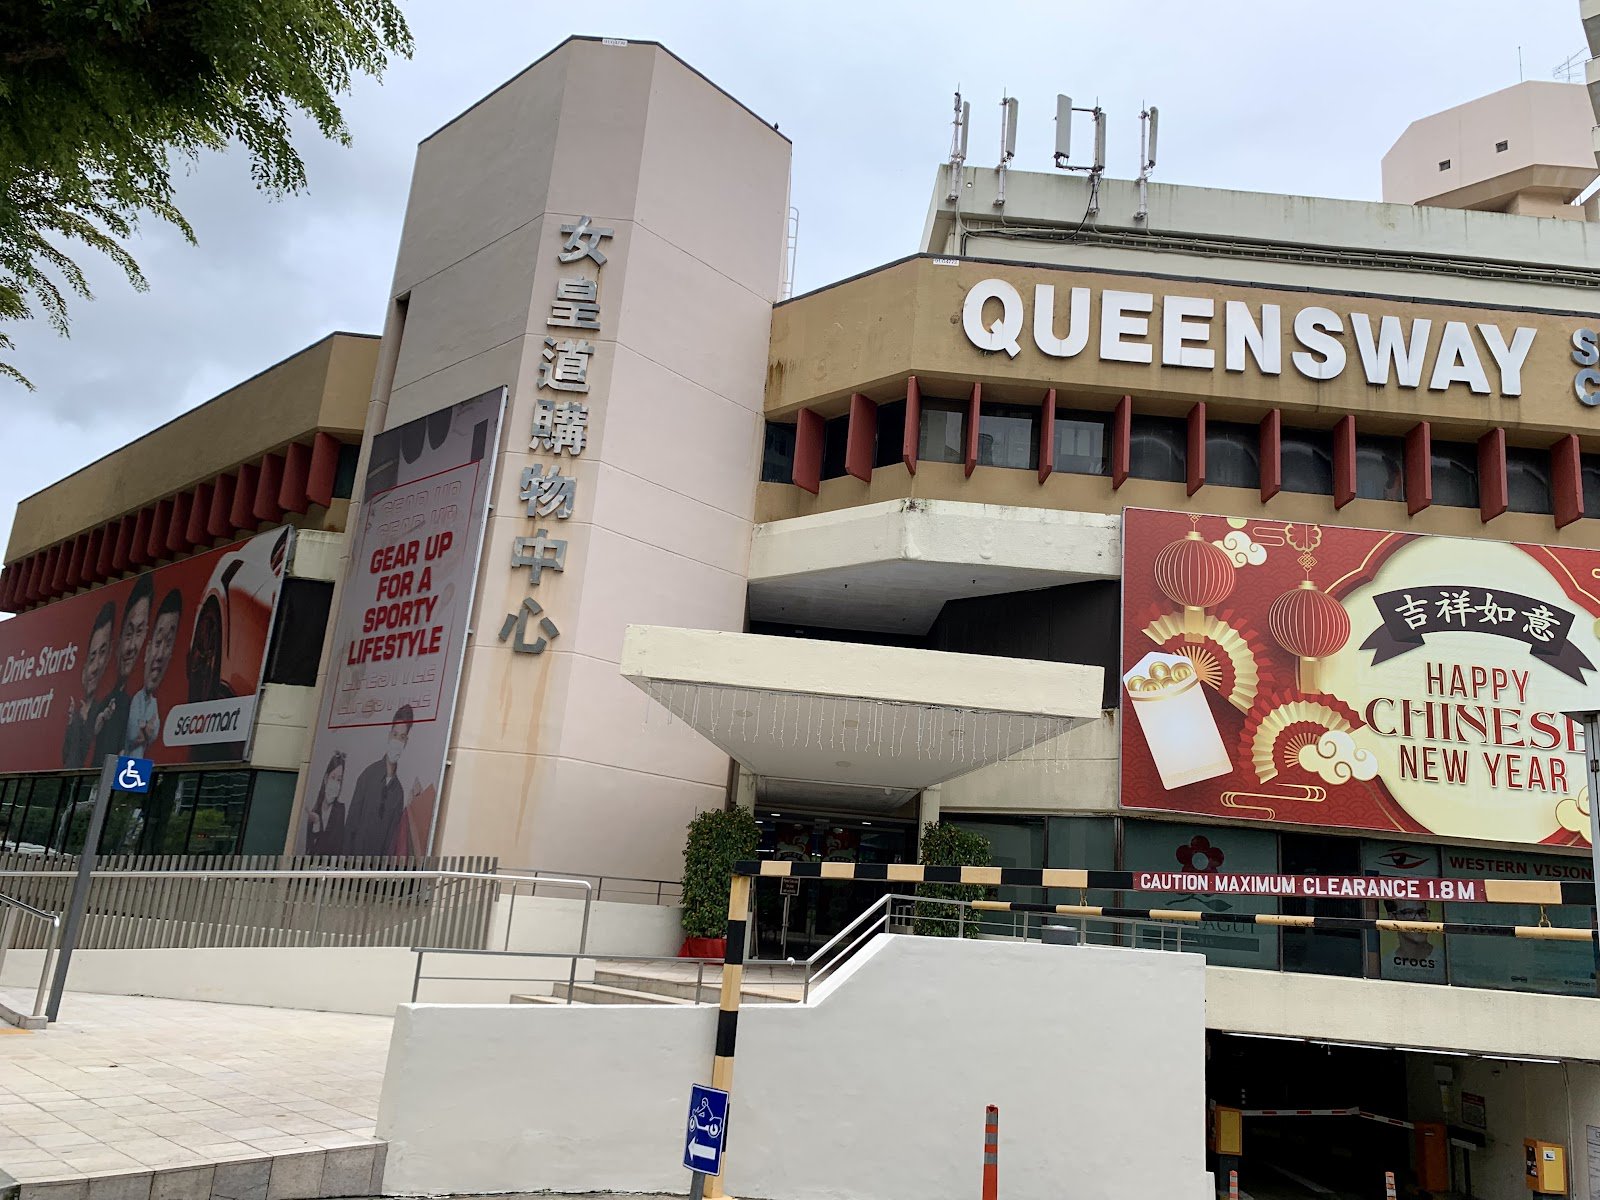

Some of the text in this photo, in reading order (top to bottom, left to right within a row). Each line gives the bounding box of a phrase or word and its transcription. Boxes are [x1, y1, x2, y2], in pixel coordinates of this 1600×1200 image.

[961, 278, 1538, 398] QUEENSWAY
[498, 214, 615, 655] 女皇道購物中心
[370, 531, 453, 574] GEAR UP
[376, 566, 432, 602] FOR A
[363, 595, 438, 634] SPORTY
[1395, 589, 1561, 642] 吉祥如意
[1, 642, 78, 685] Drive Starts
[347, 625, 443, 666] LIFESTYLE
[1425, 662, 1530, 704] HAPPY
[1399, 744, 1569, 794] NEW YEAR
[1140, 873, 1208, 891] CAUTION
[1215, 875, 1296, 894] MAXIMUM
[1303, 877, 1420, 898] CLEARANCE
[1427, 880, 1454, 899] 1.8
[1449, 856, 1593, 881] WESTERN VISION
[1393, 956, 1435, 969] crocs
